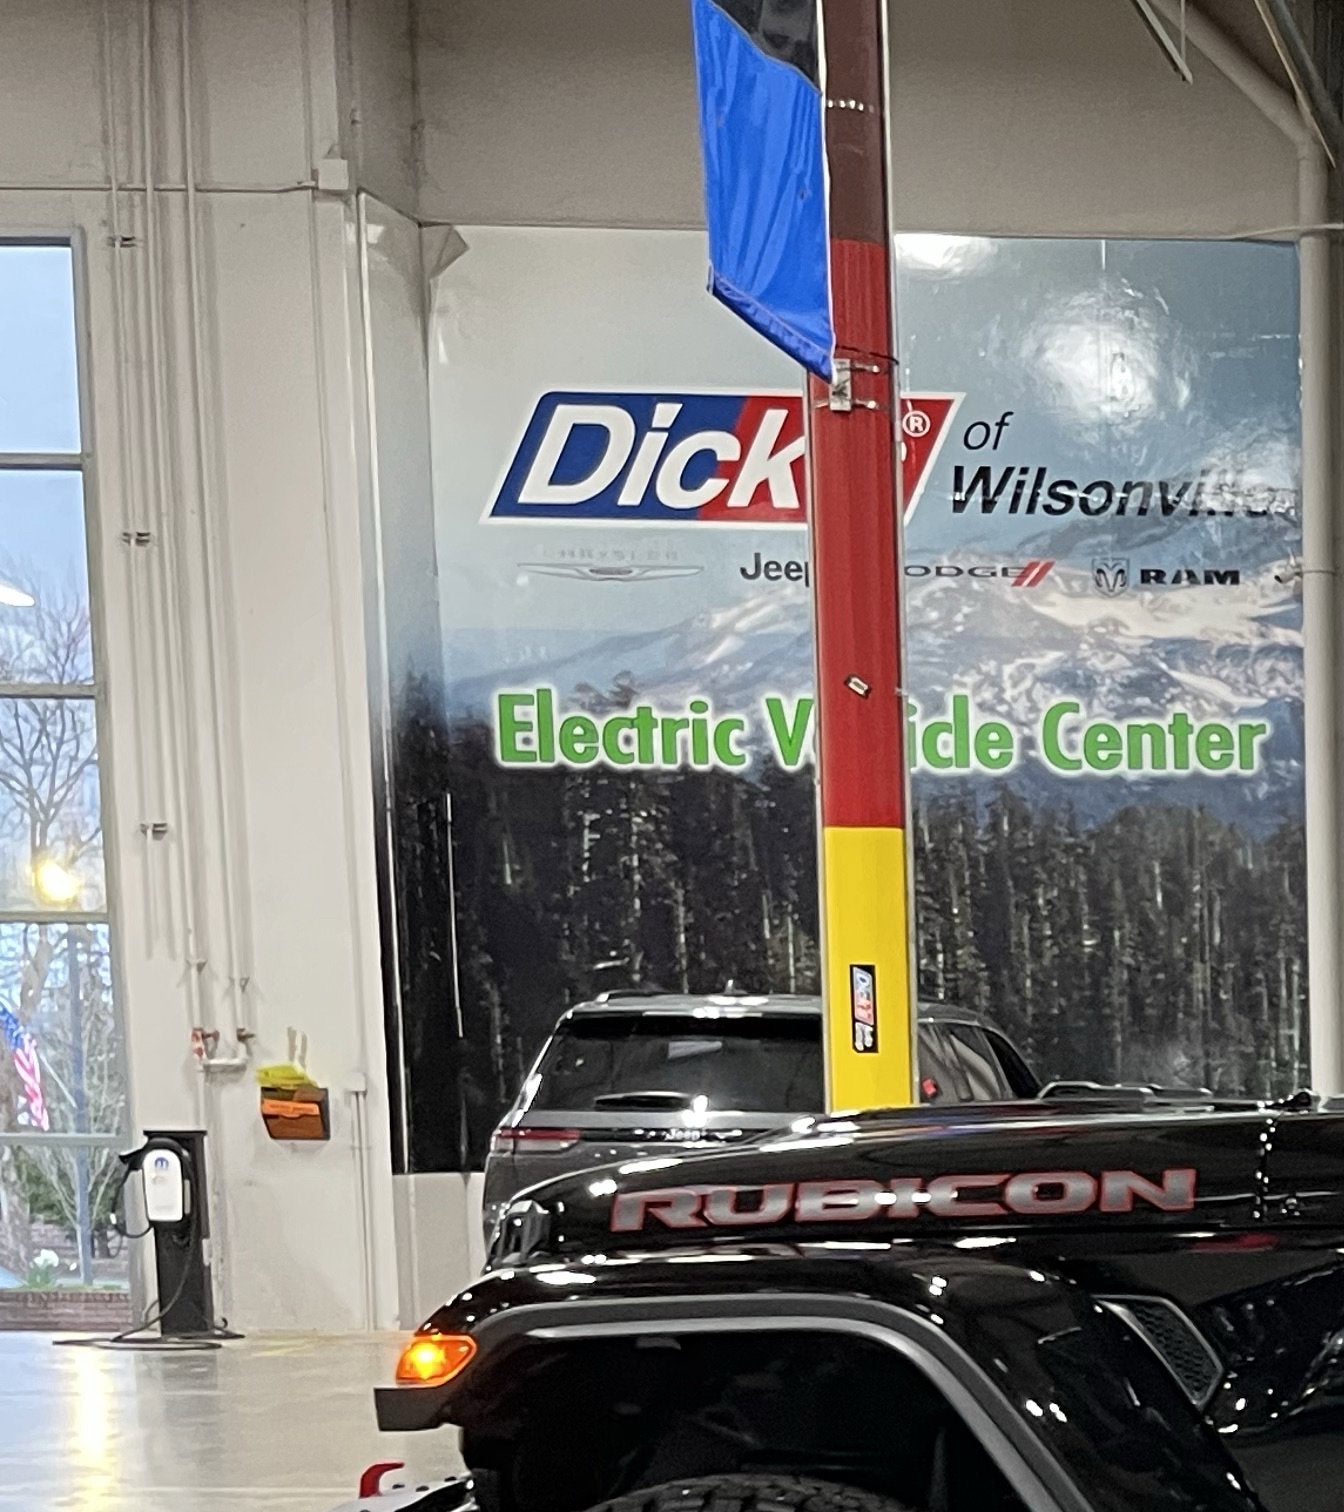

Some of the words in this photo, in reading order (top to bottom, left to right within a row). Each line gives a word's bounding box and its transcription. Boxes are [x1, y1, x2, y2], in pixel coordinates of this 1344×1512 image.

[963, 411, 1014, 451] of
[517, 403, 808, 510] Dick
[950, 465, 1273, 518] Wilsonvi
[740, 552, 809, 588] Jee
[903, 564, 1026, 578] ODGE
[1140, 568, 1240, 586] RAM
[498, 688, 747, 766] Electric
[766, 694, 1014, 770] Vicle
[1043, 702, 1267, 770] Center
[610, 1168, 1197, 1233] RUBICON
